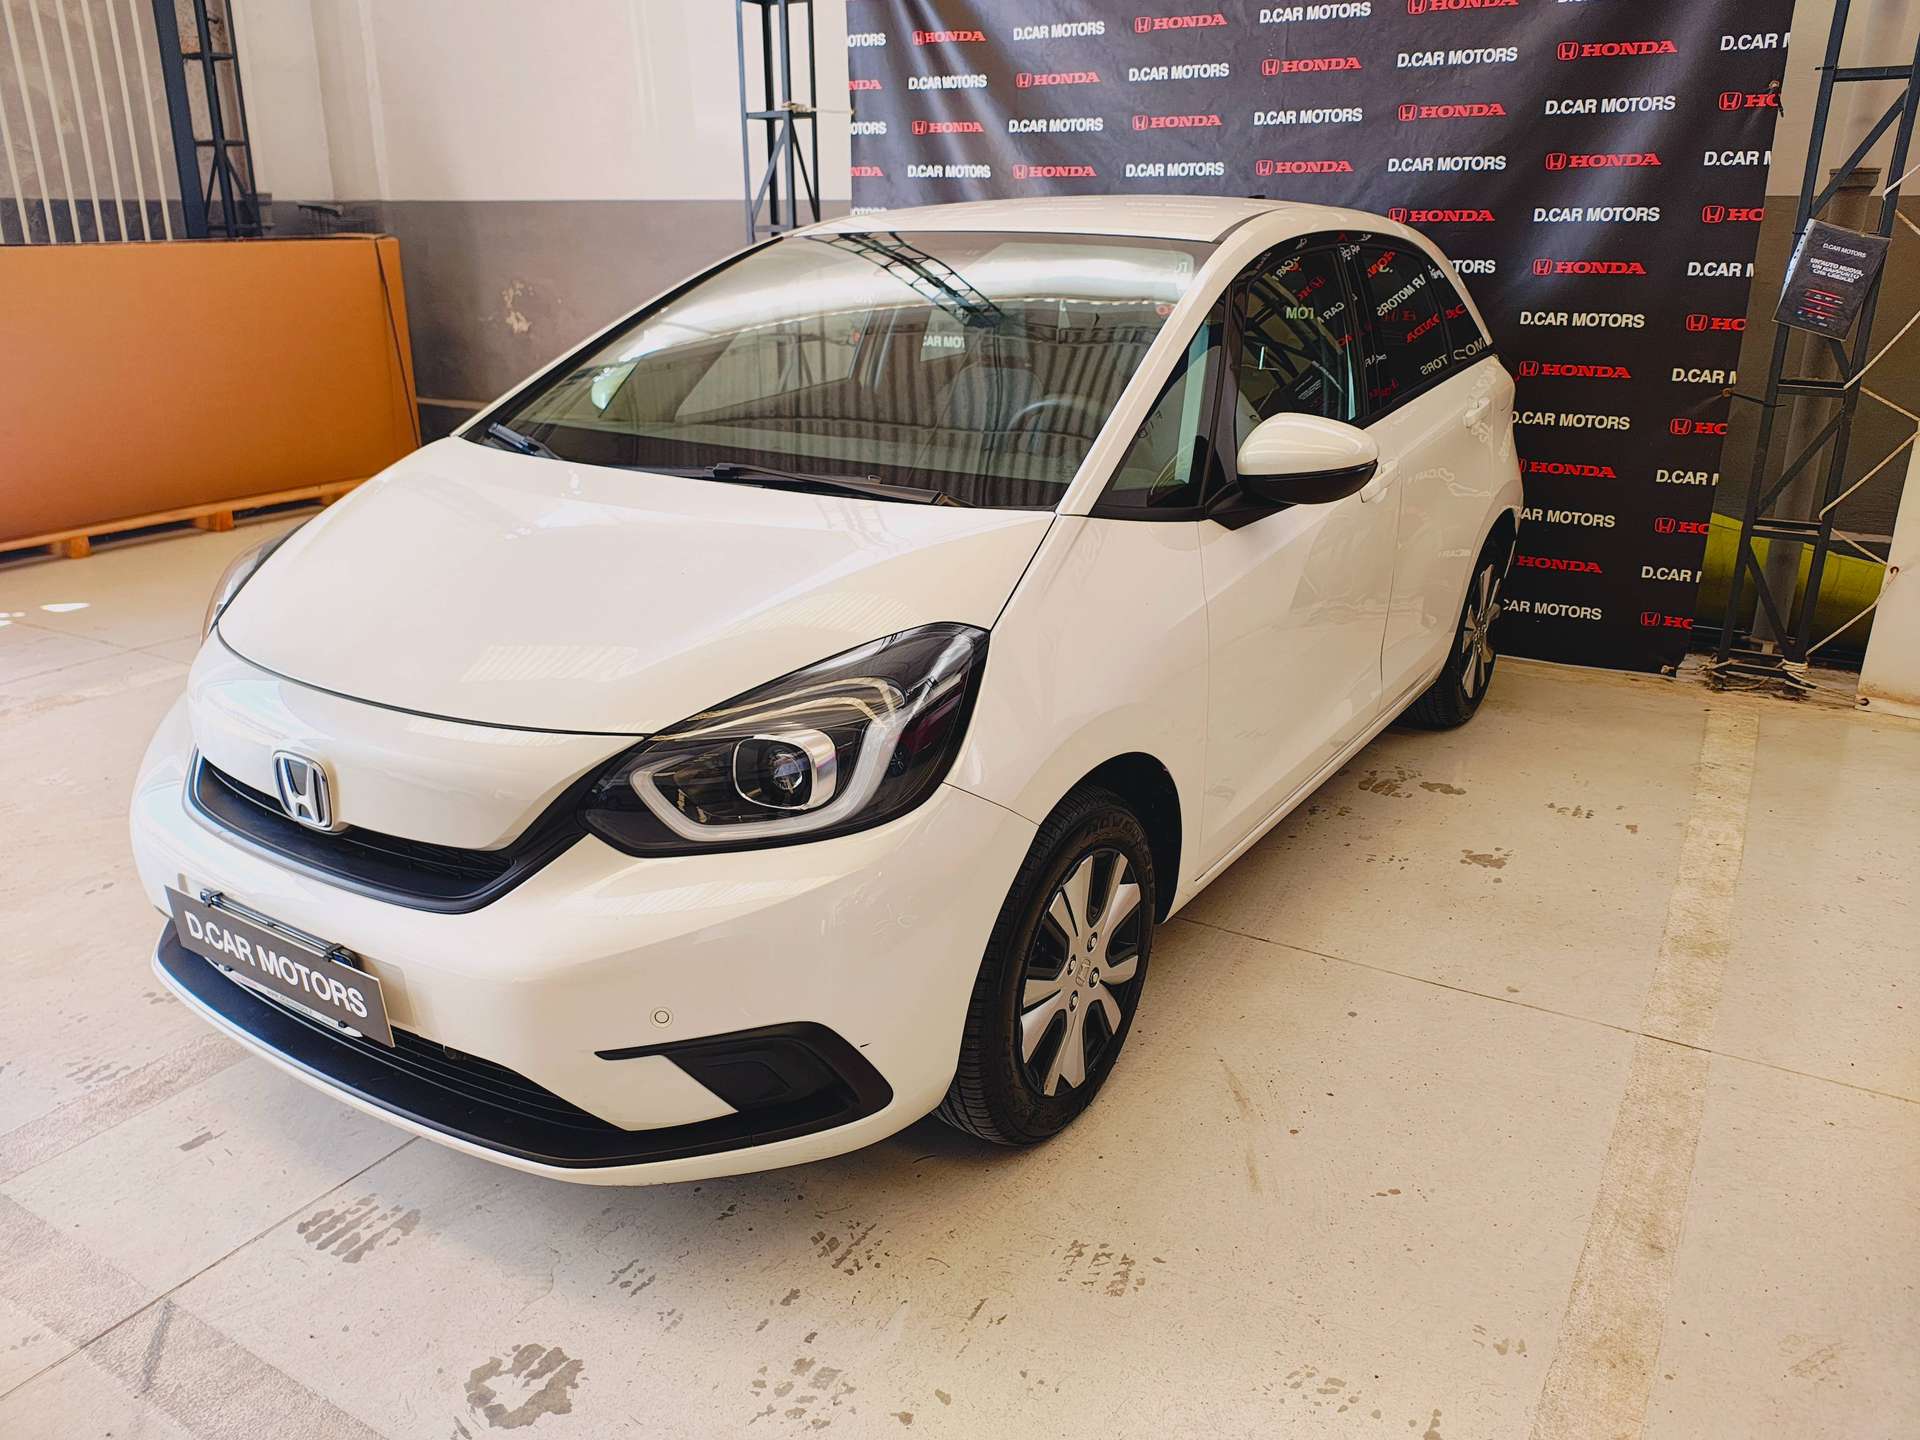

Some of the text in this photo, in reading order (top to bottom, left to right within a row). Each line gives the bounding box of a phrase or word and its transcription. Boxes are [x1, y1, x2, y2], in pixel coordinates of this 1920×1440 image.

[1260, 2, 1371, 23] D.CAR MOTORS
[1153, 14, 1227, 29] HONDA
[925, 31, 986, 43] HONDA
[1013, 21, 1105, 41] D.CAR MOTORS
[1581, 40, 1677, 57] HONDA
[1720, 33, 1778, 50] D.CAR
[1281, 57, 1361, 72] HONDA
[1397, 47, 1518, 67] D.CAR MOTORS
[1033, 72, 1100, 85] HONDA
[1129, 62, 1229, 81] D.CAR MOTORS
[908, 75, 987, 90] D.CAR MOTORS
[1419, 103, 1506, 118] HONDA
[1545, 96, 1676, 115] D.CAR MOTORS
[1151, 115, 1222, 128] HONDA
[1254, 108, 1362, 125] D.CAR MOTORS
[928, 122, 984, 133] HONDA
[1008, 117, 1103, 133] D.CAR MOTORS
[1387, 156, 1507, 172] D.CAR MOTORS
[1569, 153, 1661, 168] HONDA
[1704, 151, 1758, 166] D.CAR
[908, 164, 991, 178] D.CAR MOTORS
[1028, 166, 1096, 177] HONDA
[1126, 162, 1224, 177] D.CAR MOTORS
[1275, 161, 1353, 174] HONDA
[1409, 209, 1495, 222] HONDA
[1533, 207, 1660, 222] D.CAR MOTORS
[1554, 261, 1647, 275] HONDA
[1687, 262, 1741, 277] D.CAR
[1520, 312, 1645, 328] D.CAR MOTORS
[1541, 364, 1632, 379] HONDA
[1671, 368, 1724, 383] D.CAR
[1559, 413, 1631, 430] MOTORS
[1529, 462, 1617, 478] HONDA
[1656, 470, 1707, 485] D.CAR
[1546, 510, 1616, 528] MOTORS
[1517, 555, 1603, 574] HONDA
[1641, 566, 1691, 582] D.CAR
[1534, 602, 1602, 621] MOTORS
[184, 911, 256, 967] D.CAR
[256, 944, 368, 1019] MOTORS
